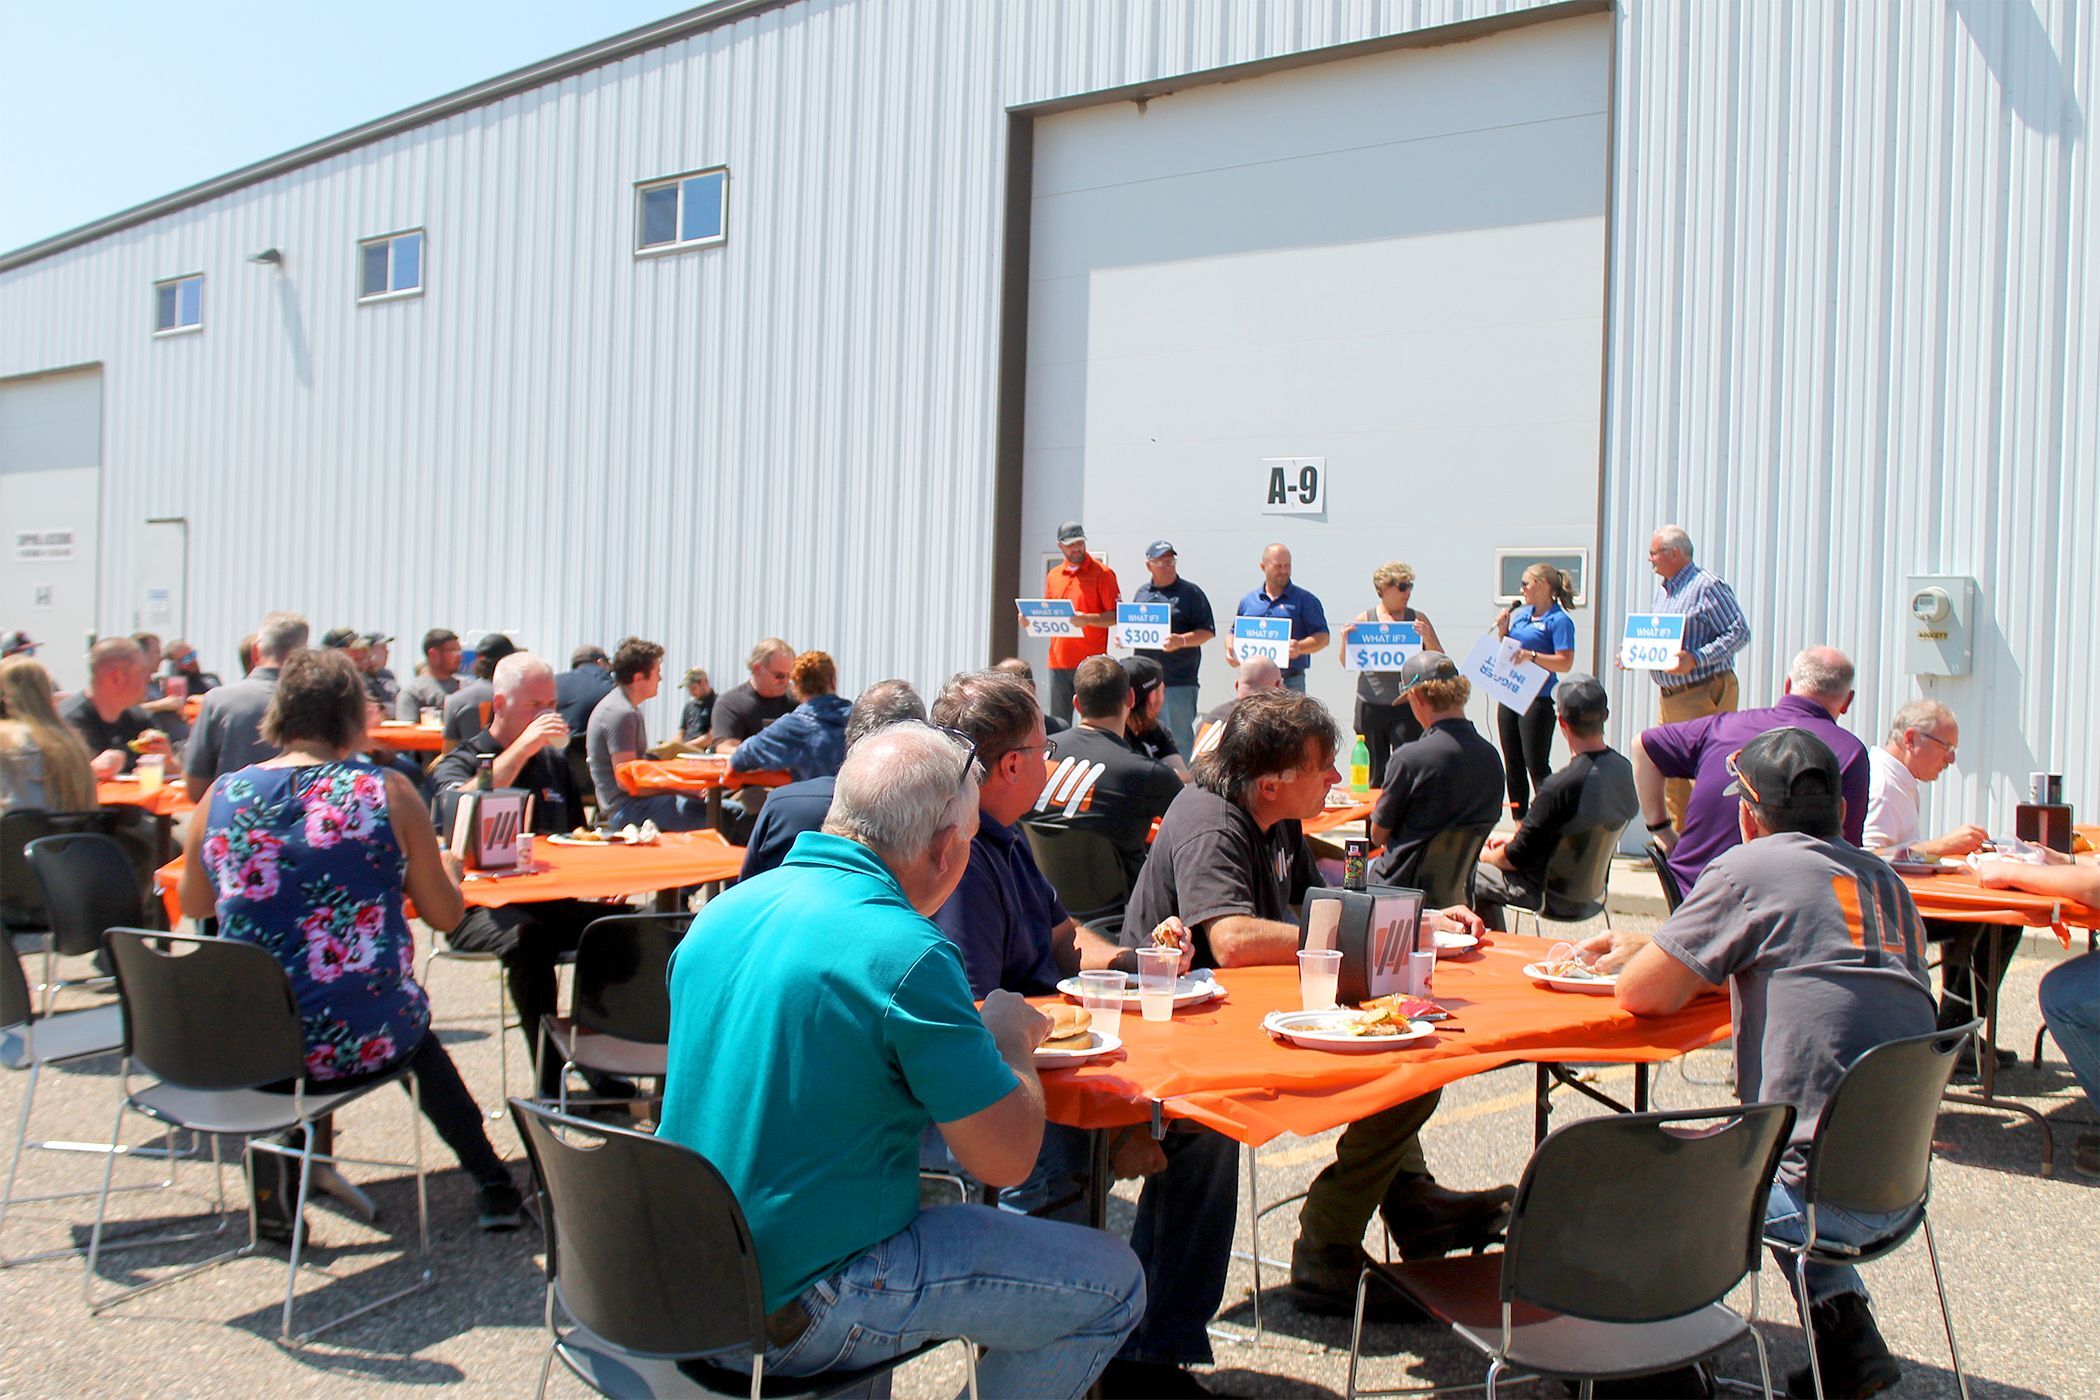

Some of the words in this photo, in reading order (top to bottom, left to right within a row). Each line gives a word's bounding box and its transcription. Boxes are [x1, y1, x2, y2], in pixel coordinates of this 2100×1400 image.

[1267, 465, 1318, 504] A-9
[1127, 614, 1148, 622] WHAT
[1149, 614, 1160, 623] IF?
[1032, 620, 1070, 634] $500
[1245, 628, 1267, 638] WHAT
[1268, 629, 1279, 639] IF?
[1635, 627, 1659, 637] WHAT
[1660, 627, 1671, 638] IF?
[1125, 627, 1160, 645] $300
[1361, 634, 1390, 643] WHAT
[1392, 634, 1406, 643] IF?
[1241, 643, 1277, 660] $200
[1357, 649, 1406, 667] $100
[1628, 644, 1668, 662] $400
